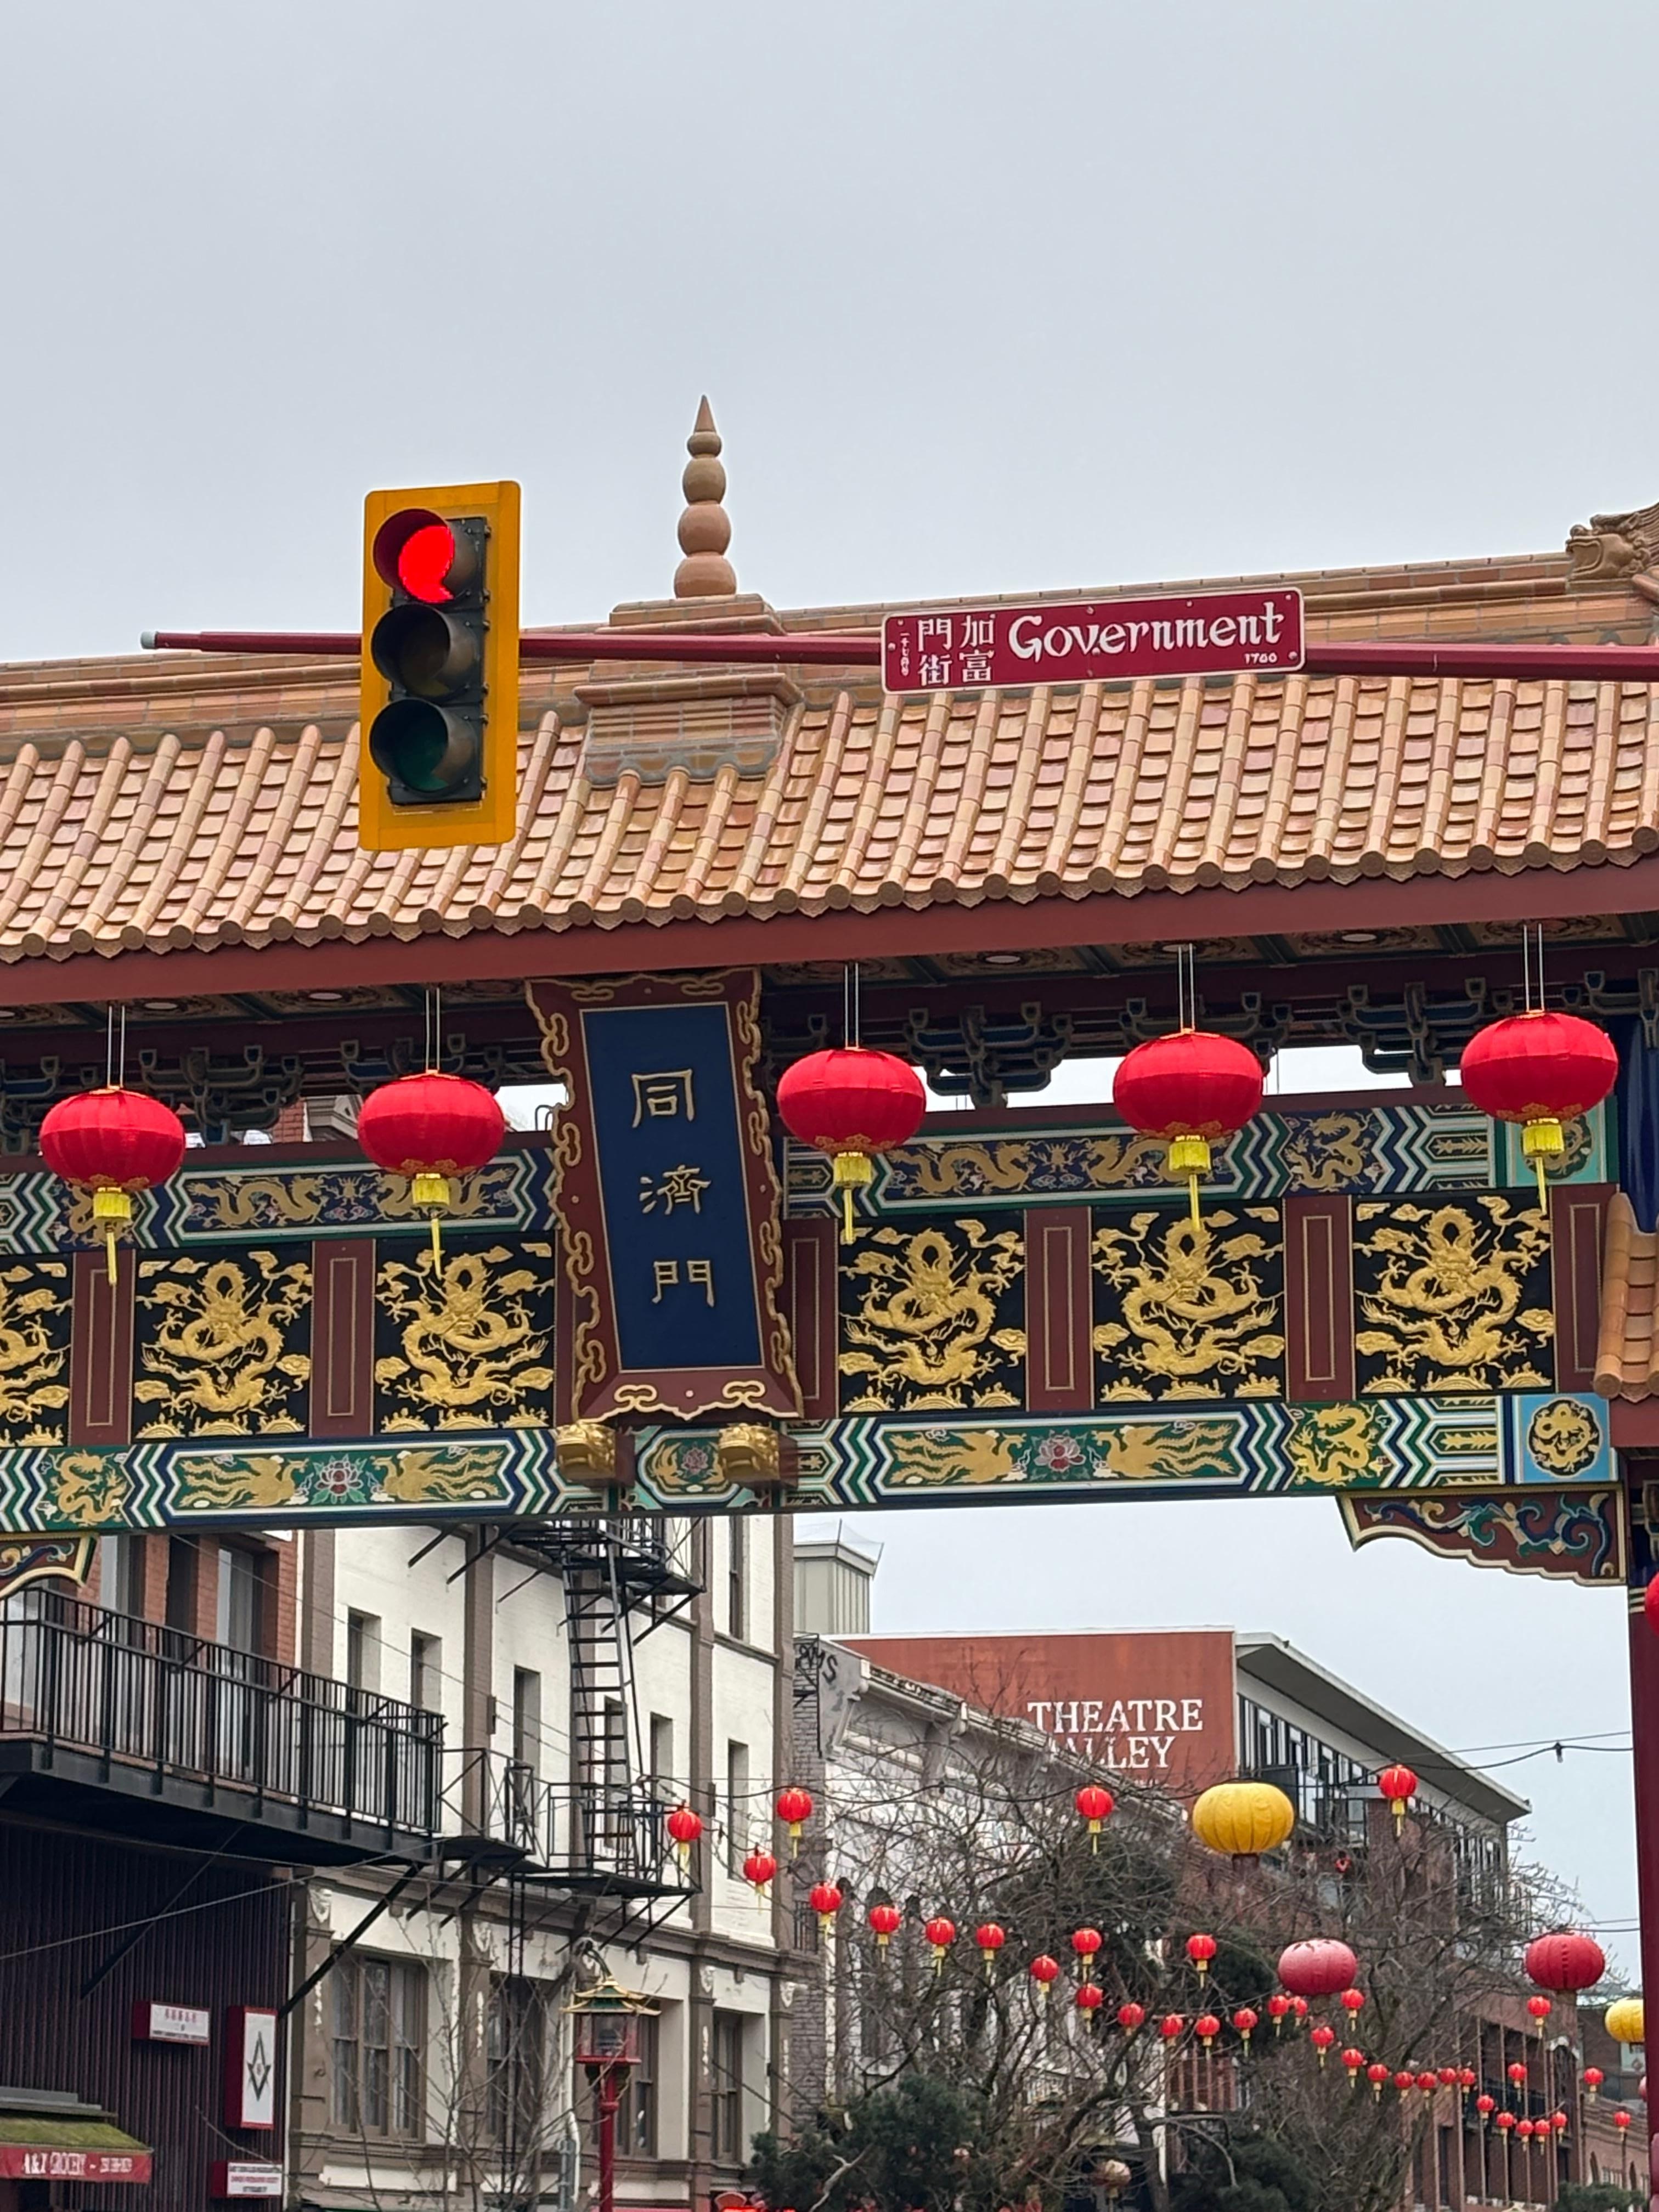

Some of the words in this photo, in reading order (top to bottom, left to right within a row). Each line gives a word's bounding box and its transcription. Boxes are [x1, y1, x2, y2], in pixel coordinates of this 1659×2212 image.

[1008, 601, 1284, 662] Government
[631, 1069, 714, 1307] 同濟門
[1027, 1699, 1203, 1733] THEATRE
